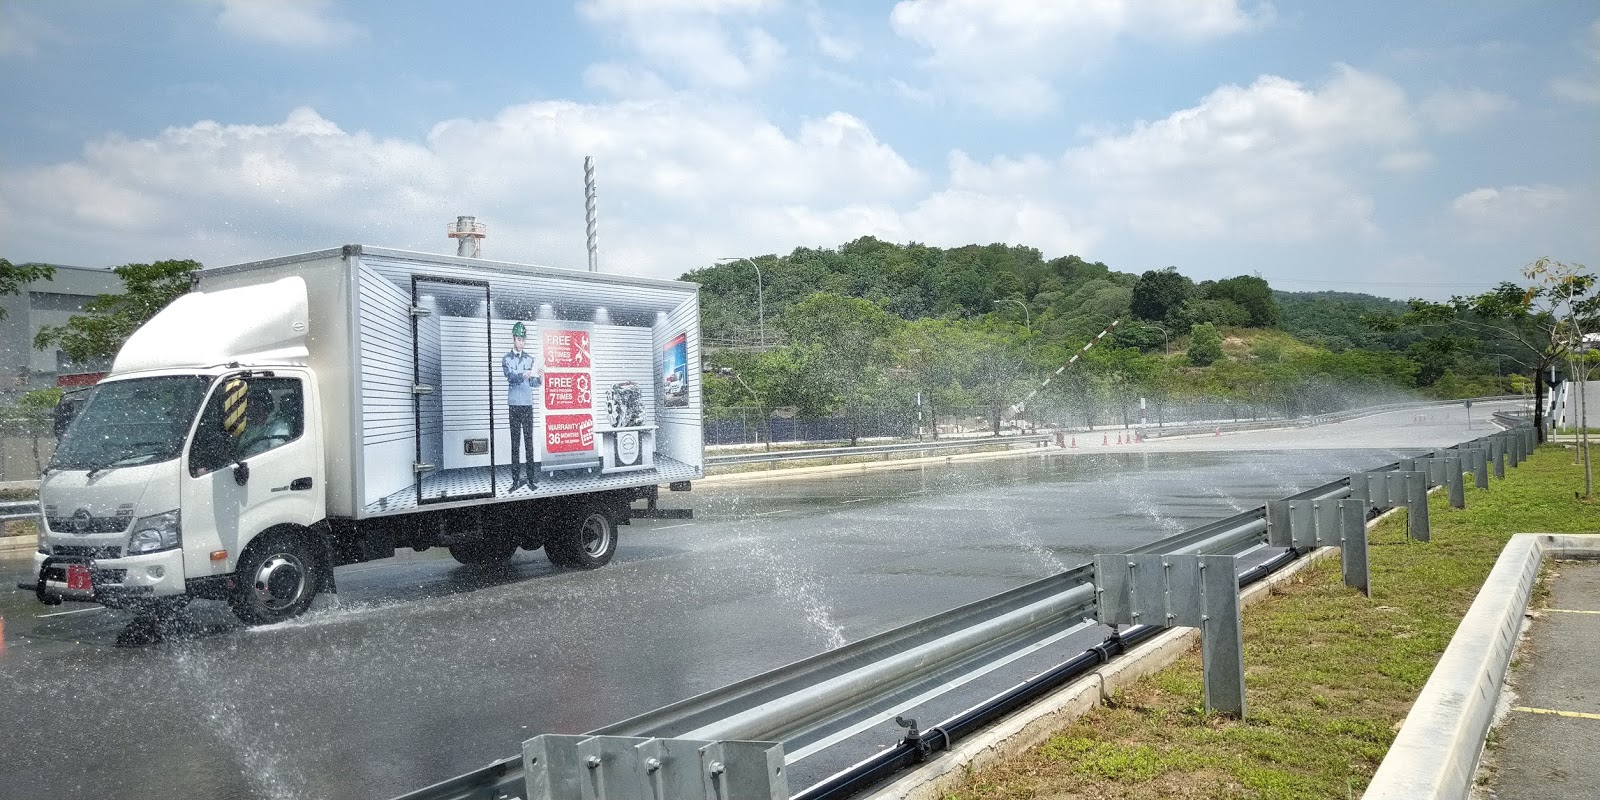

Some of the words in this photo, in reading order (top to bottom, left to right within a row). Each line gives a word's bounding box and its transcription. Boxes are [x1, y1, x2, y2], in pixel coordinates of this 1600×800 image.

[547, 335, 571, 346] FREE
[547, 350, 555, 362] 3
[549, 377, 572, 388] FREE
[549, 393, 556, 405] 7
[548, 433, 561, 444] 36
